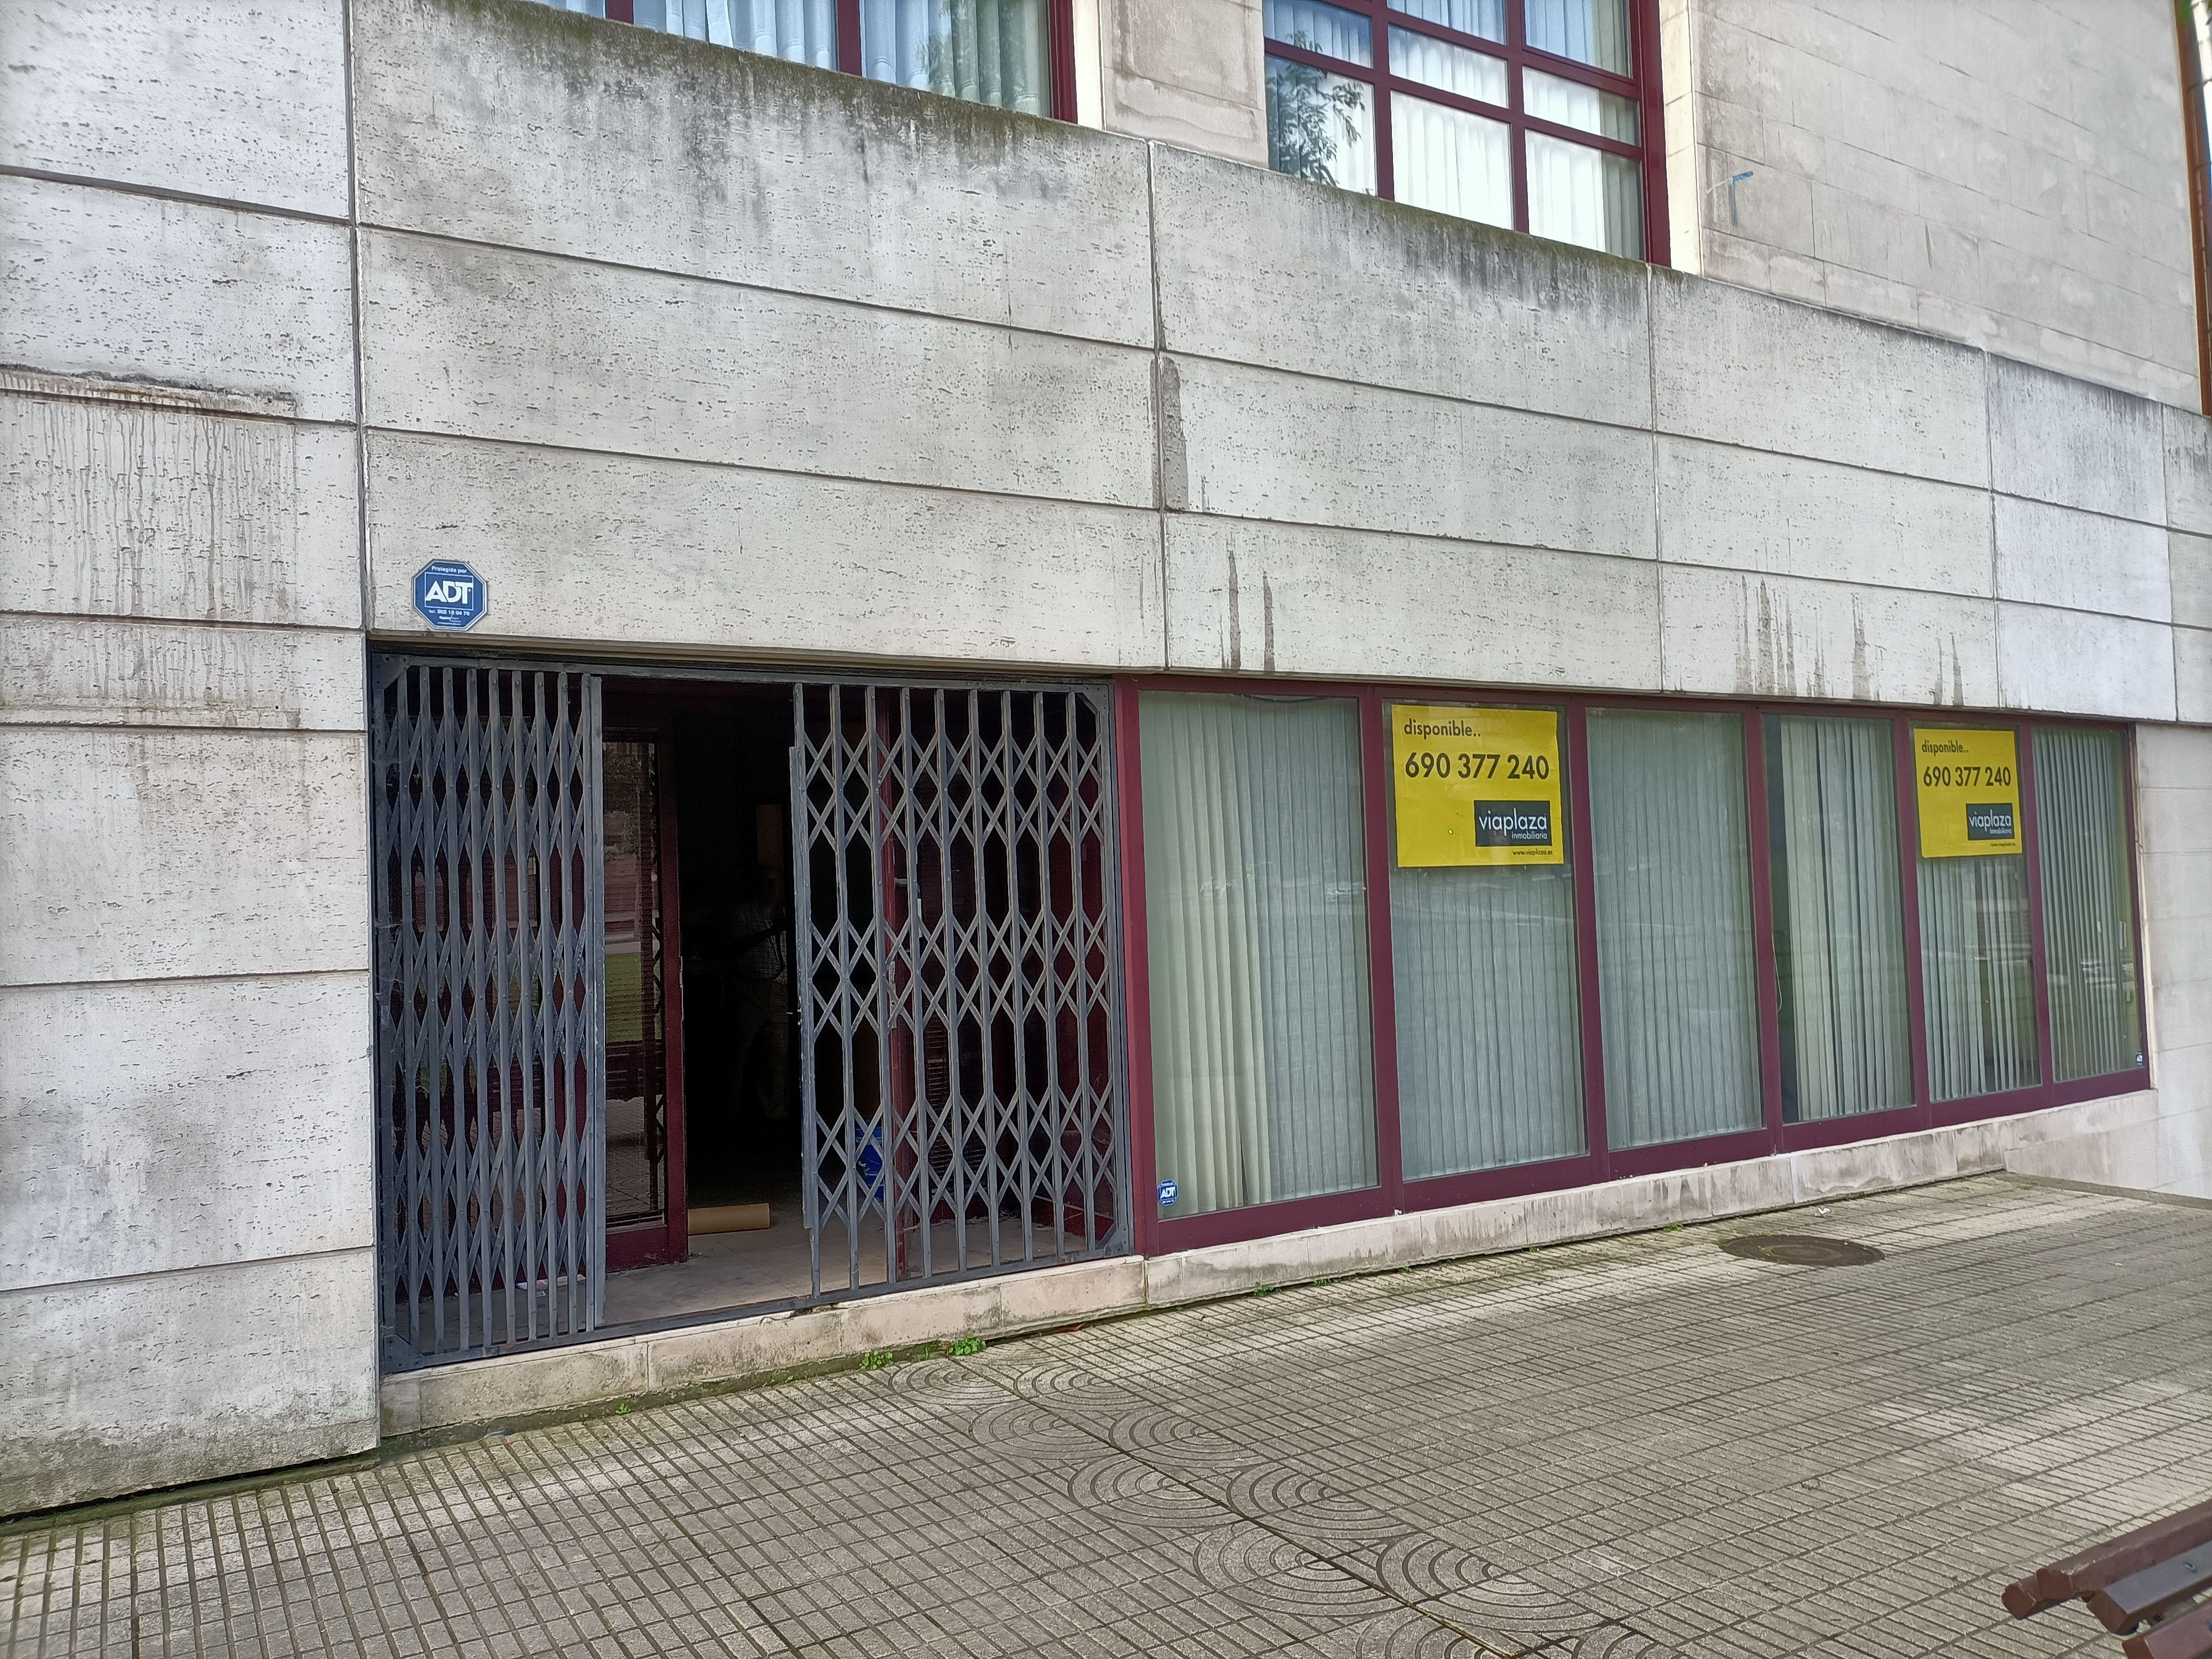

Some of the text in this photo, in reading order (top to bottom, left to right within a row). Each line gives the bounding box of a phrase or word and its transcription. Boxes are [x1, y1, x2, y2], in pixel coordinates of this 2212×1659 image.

[425, 580, 473, 604] ADT
[1405, 752, 1549, 779] 690 377 240
[1923, 766, 2011, 787] 690 377 240
[1478, 807, 1547, 836] viaplaza
[1968, 808, 2011, 832] viaplaza
[1511, 830, 1548, 840] inmobiliaria
[1160, 1187, 1176, 1198] ADT
